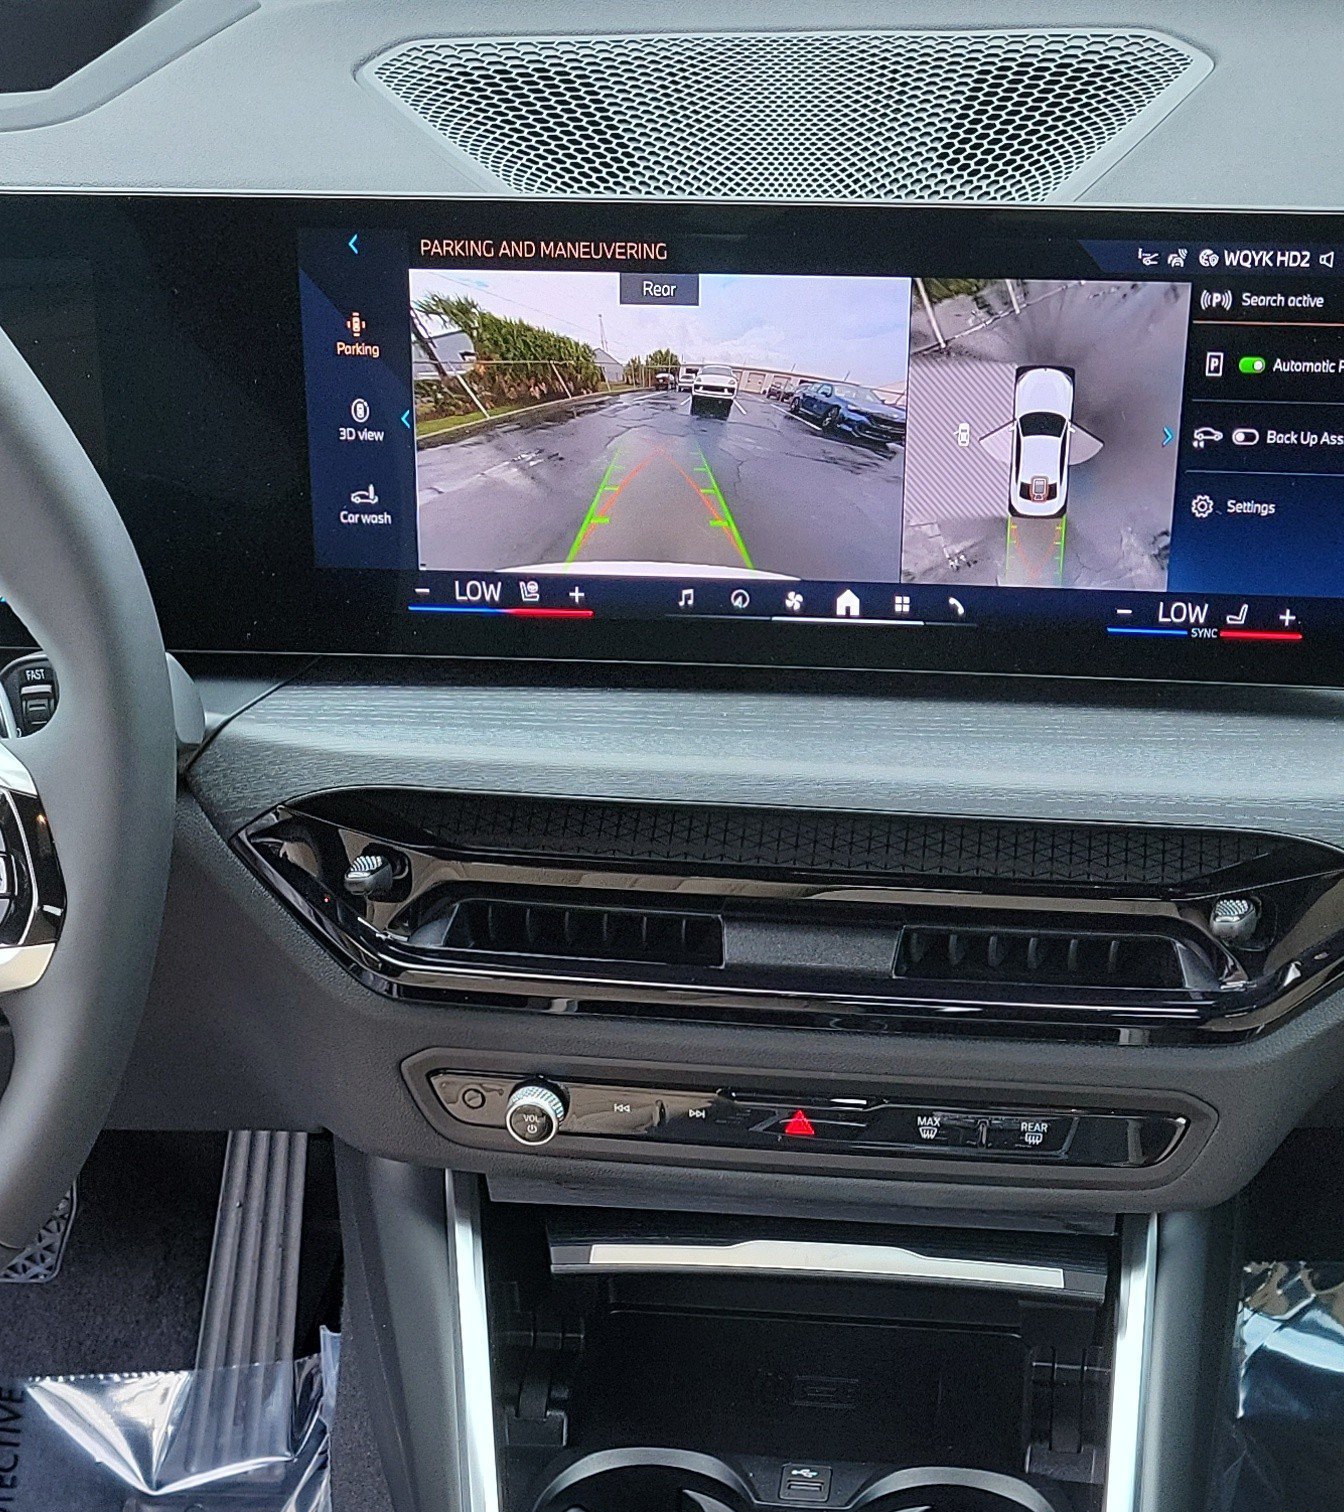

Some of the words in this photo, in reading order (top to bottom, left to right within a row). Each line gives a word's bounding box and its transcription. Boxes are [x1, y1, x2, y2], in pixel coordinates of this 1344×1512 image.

[420, 240, 494, 258] PARKING
[498, 241, 535, 258] AND
[540, 241, 668, 261] MANEUVERING
[1224, 250, 1273, 268] WQYK
[1276, 251, 1310, 268] HD2
[643, 281, 677, 298] Rear
[1242, 293, 1285, 307] Search
[1288, 294, 1324, 308] active
[336, 342, 380, 358] Parking
[1273, 358, 1336, 373] Automatic
[339, 427, 356, 441] 3D
[358, 428, 384, 442] view
[1266, 430, 1298, 445] Back
[1300, 431, 1318, 447] Up
[1227, 500, 1276, 515] Settings
[340, 510, 360, 524] Car
[360, 511, 392, 525] wash
[454, 580, 502, 602] LOW
[1158, 602, 1209, 624] LOW
[1191, 627, 1218, 639] SYNC
[26, 668, 46, 681] FAST
[523, 1114, 540, 1123] VOL
[917, 1116, 941, 1128] MAX
[1020, 1122, 1048, 1132] REAR
